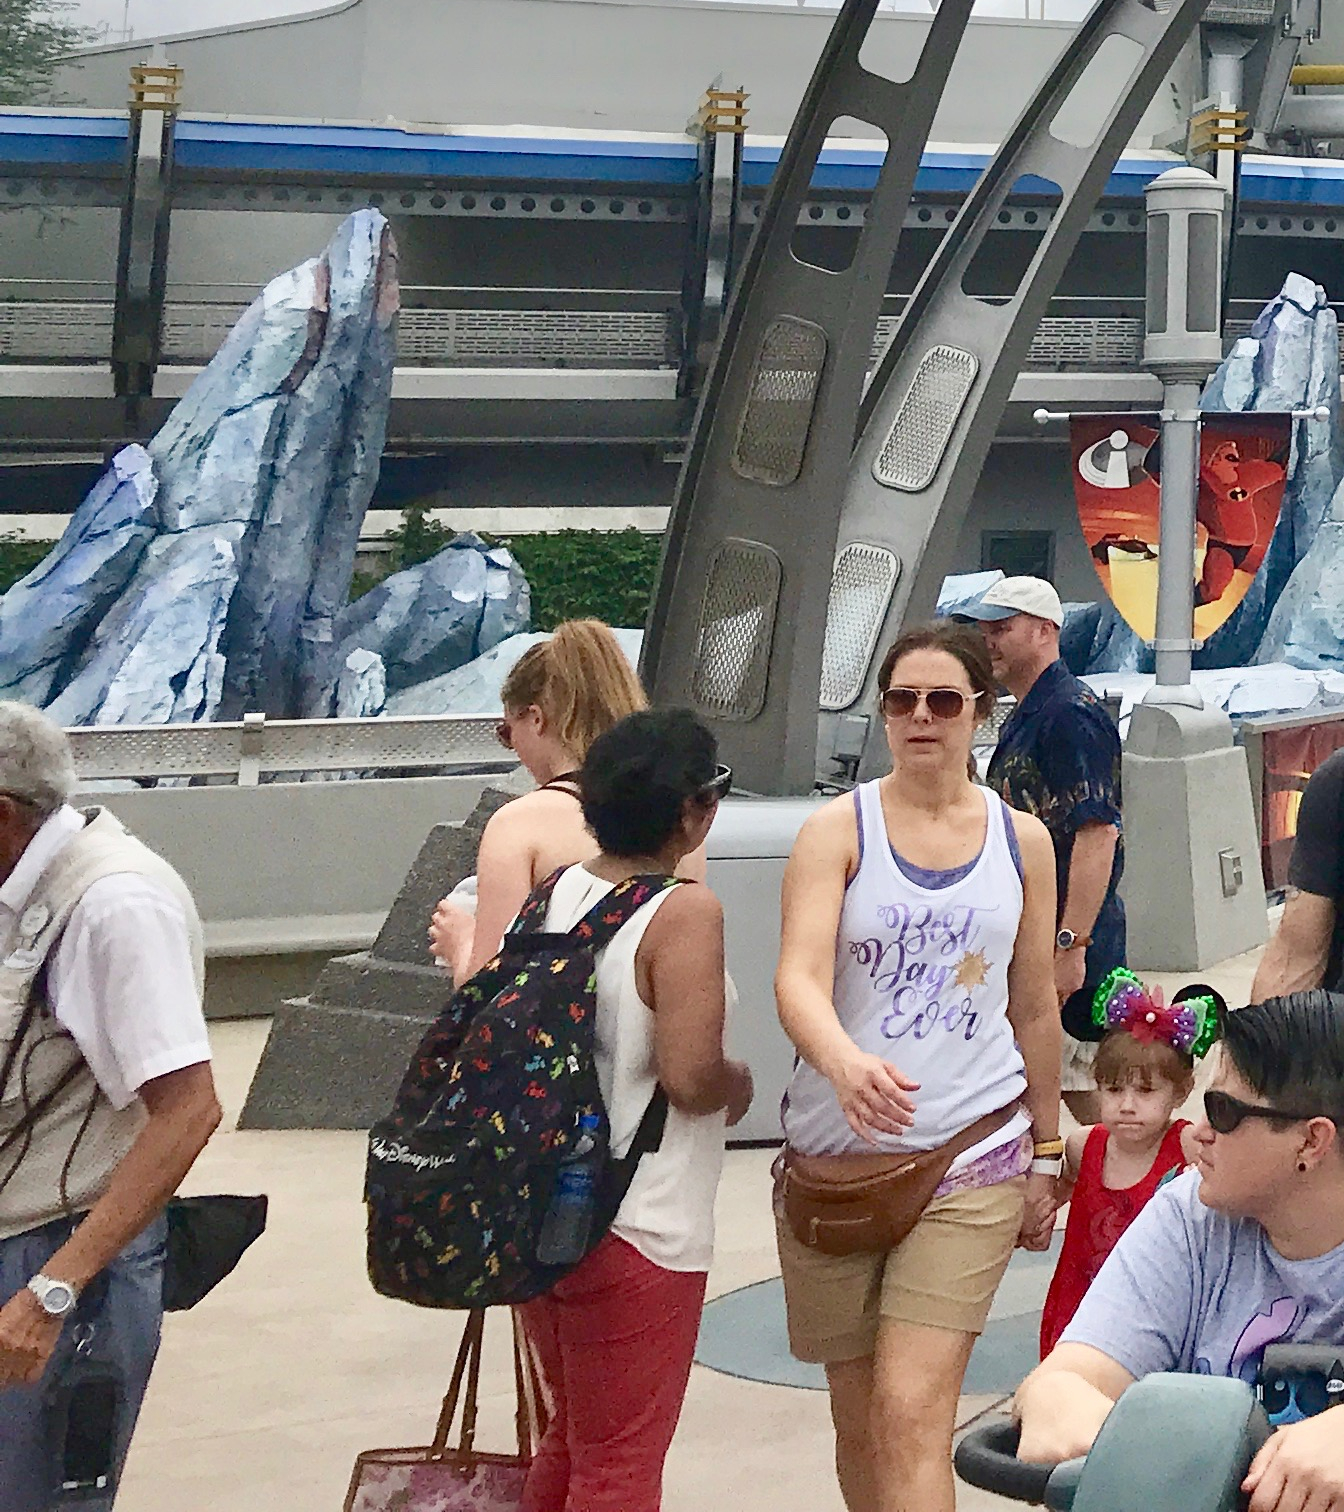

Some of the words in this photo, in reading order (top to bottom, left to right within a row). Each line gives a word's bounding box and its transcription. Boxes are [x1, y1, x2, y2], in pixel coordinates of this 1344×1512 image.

[877, 903, 1000, 956] Best
[848, 938, 956, 1001] Day
[880, 986, 983, 1040] Ever
